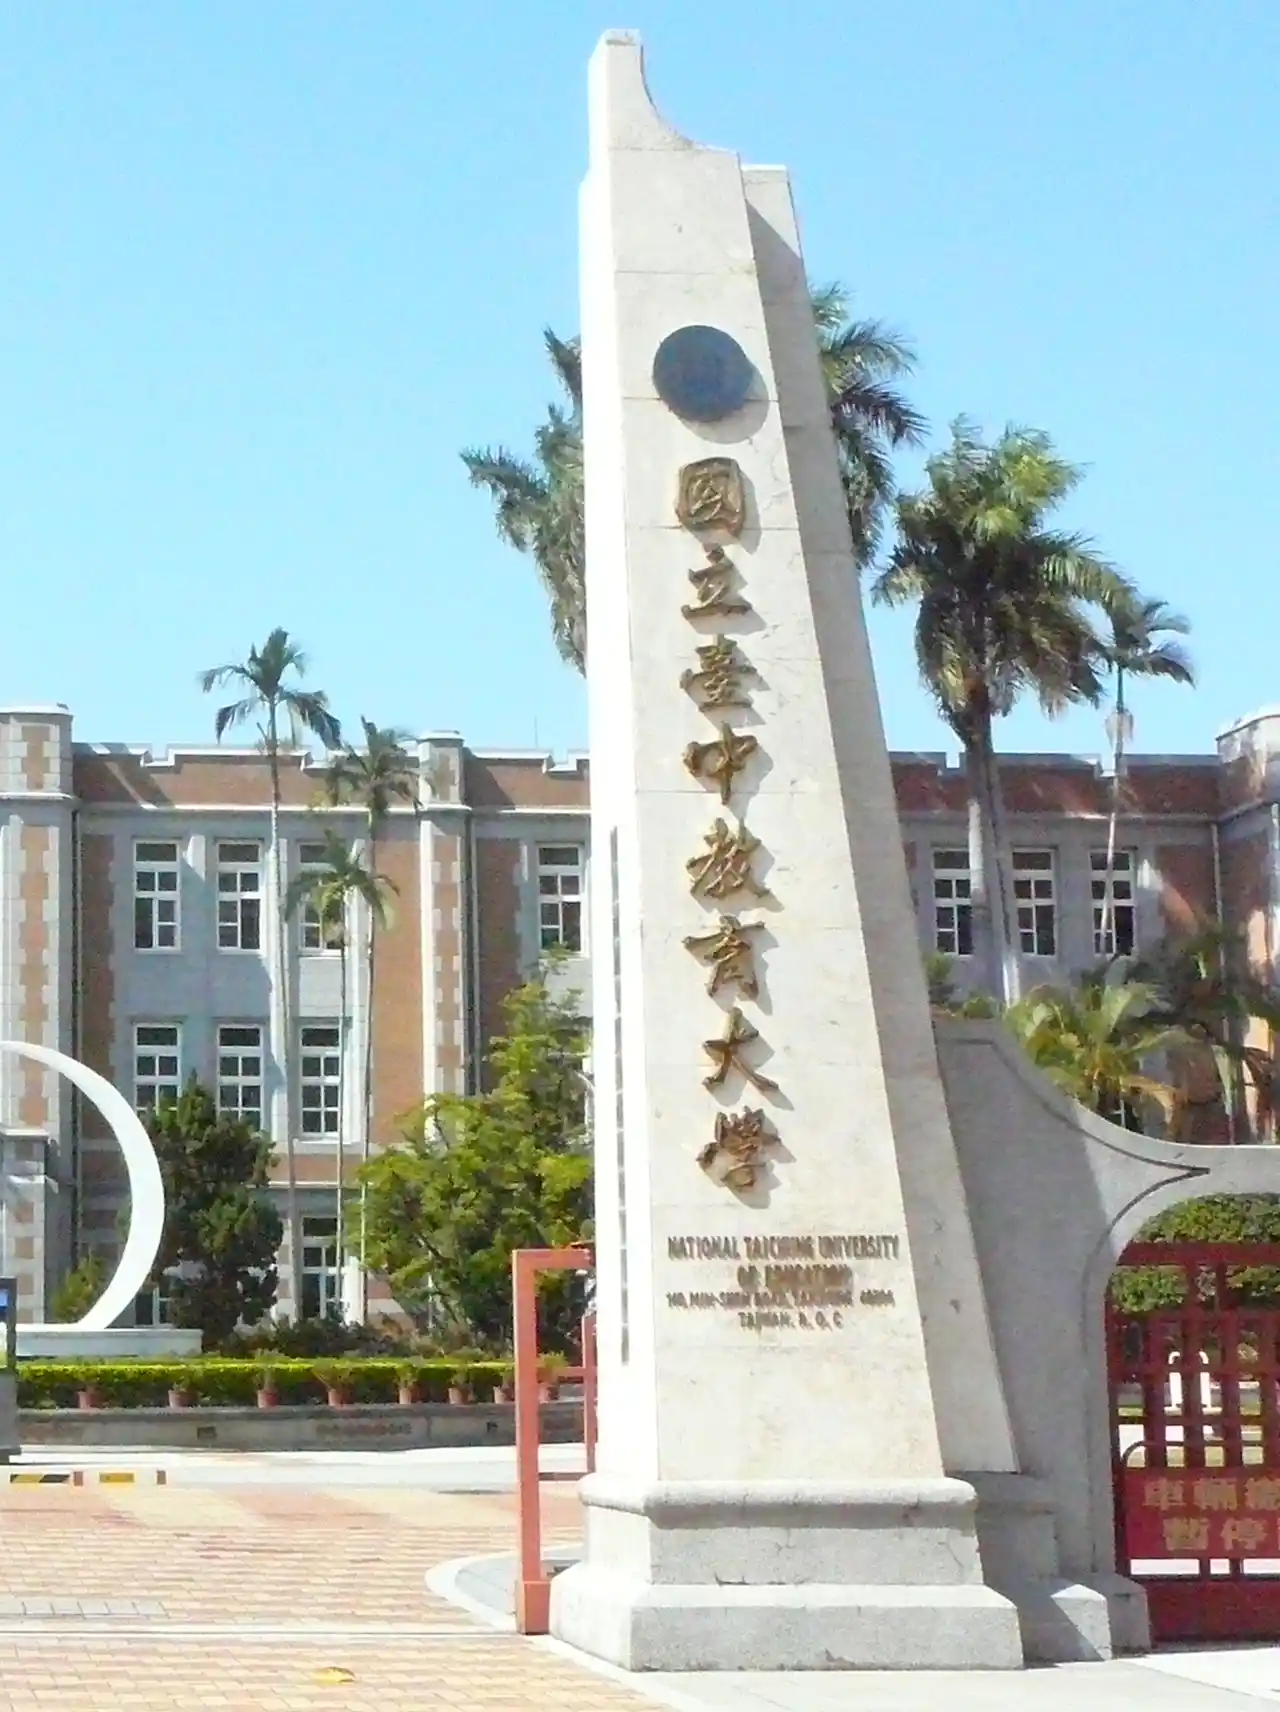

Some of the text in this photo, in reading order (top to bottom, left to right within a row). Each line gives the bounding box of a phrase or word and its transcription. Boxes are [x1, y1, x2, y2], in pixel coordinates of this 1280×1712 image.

[675, 457, 780, 1191] 國立臺中教育大學
[668, 1236, 741, 1260] NATIONAL
[818, 1235, 899, 1260] UNIVERSITY
